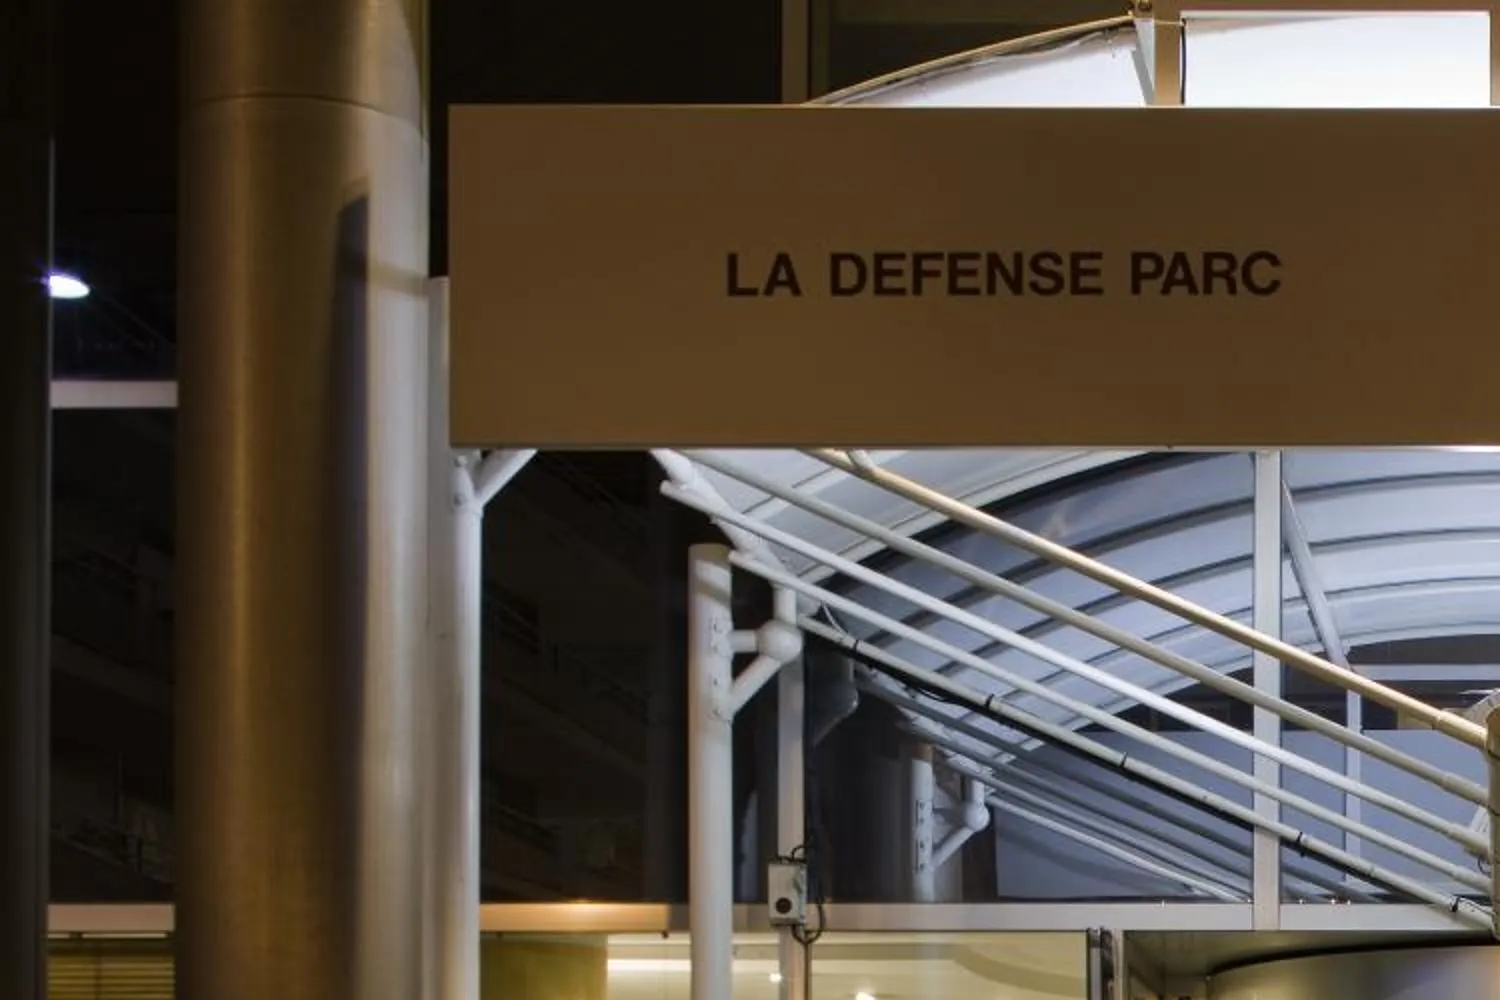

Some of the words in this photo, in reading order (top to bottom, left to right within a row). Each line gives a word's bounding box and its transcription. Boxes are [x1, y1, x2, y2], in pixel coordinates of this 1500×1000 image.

[726, 252, 803, 298] LA
[829, 252, 1105, 298] DEFENSE
[1130, 251, 1282, 297] PARC
